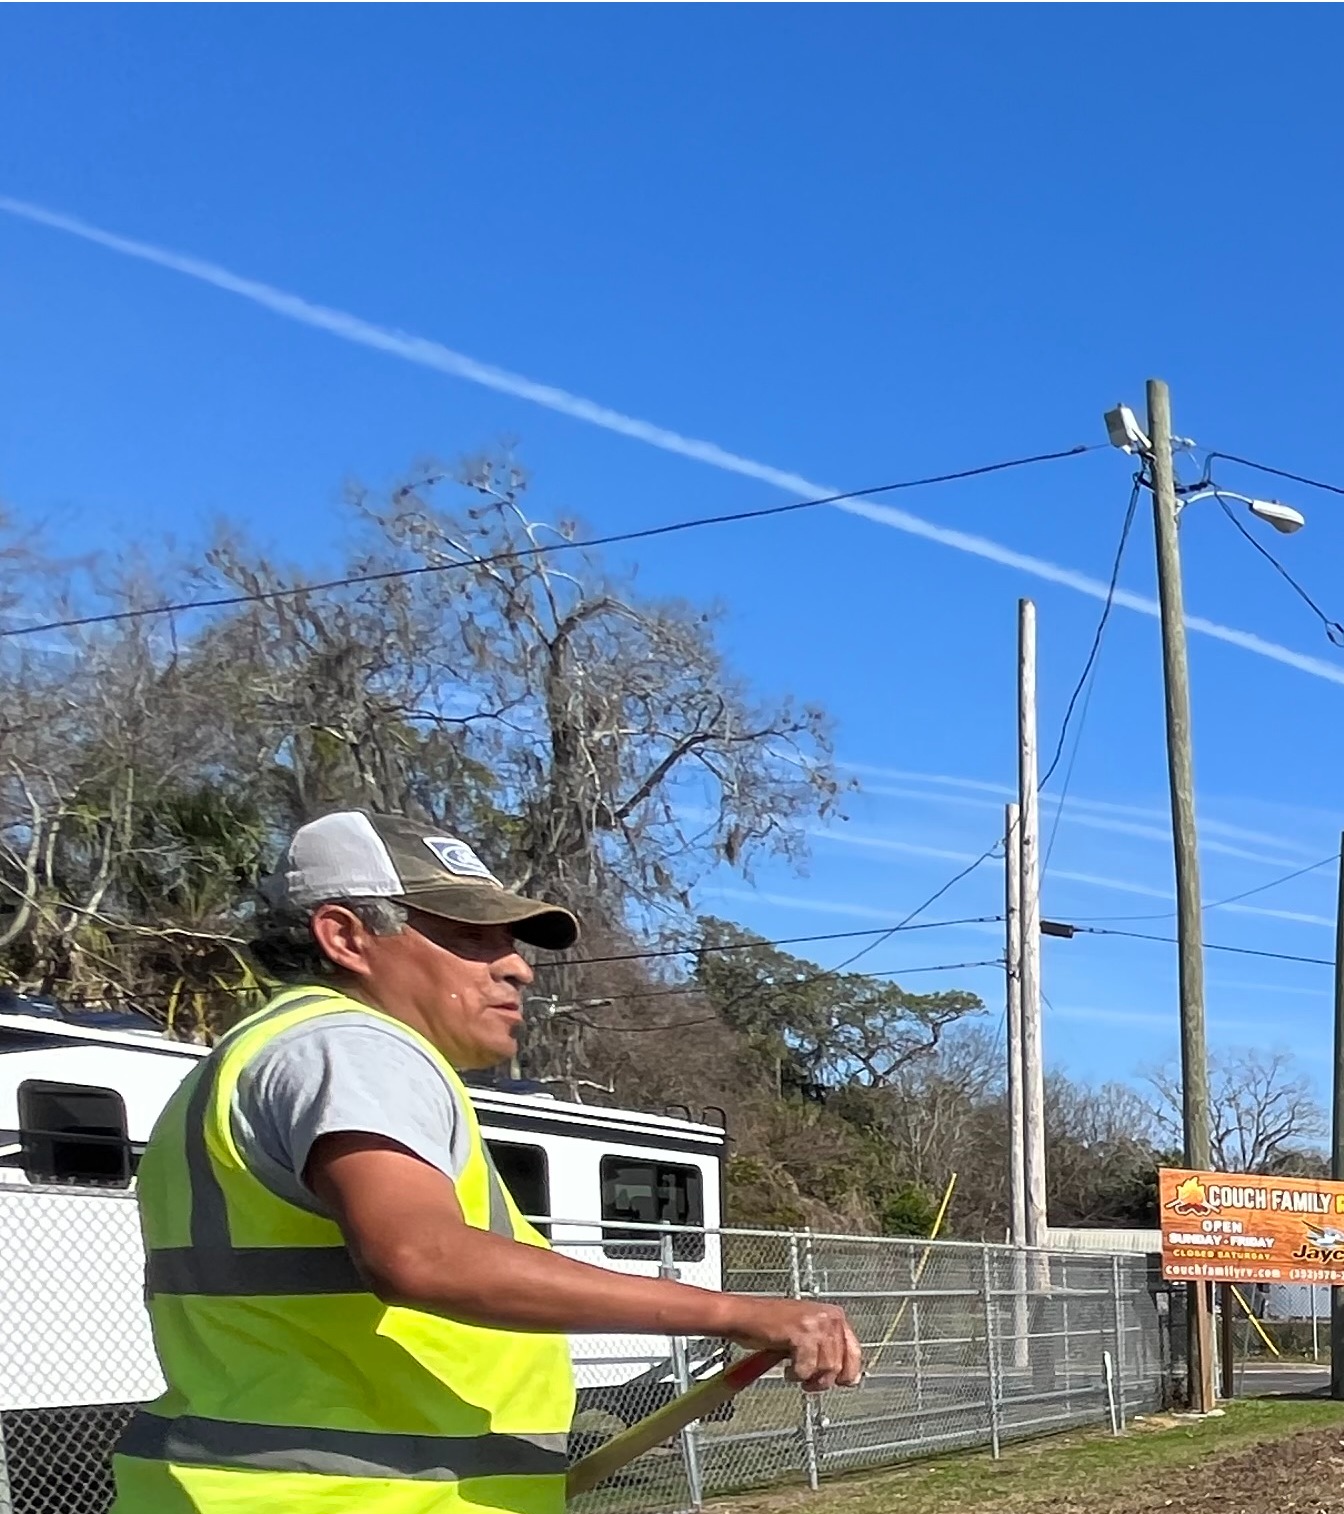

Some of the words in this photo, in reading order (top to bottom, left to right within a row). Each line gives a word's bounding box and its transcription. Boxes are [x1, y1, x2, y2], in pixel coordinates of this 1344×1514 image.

[1208, 1185, 1268, 1210] COUCH
[1271, 1188, 1332, 1214] FAMILY
[1202, 1219, 1243, 1234] OPEN
[1168, 1232, 1223, 1246] SUNDAY
[1229, 1235, 1275, 1248] FRIDAY
[1172, 1248, 1215, 1258] CLOSED
[1216, 1250, 1271, 1261] SATURDAY
[1165, 1263, 1281, 1279] couchfamilyrv.com
